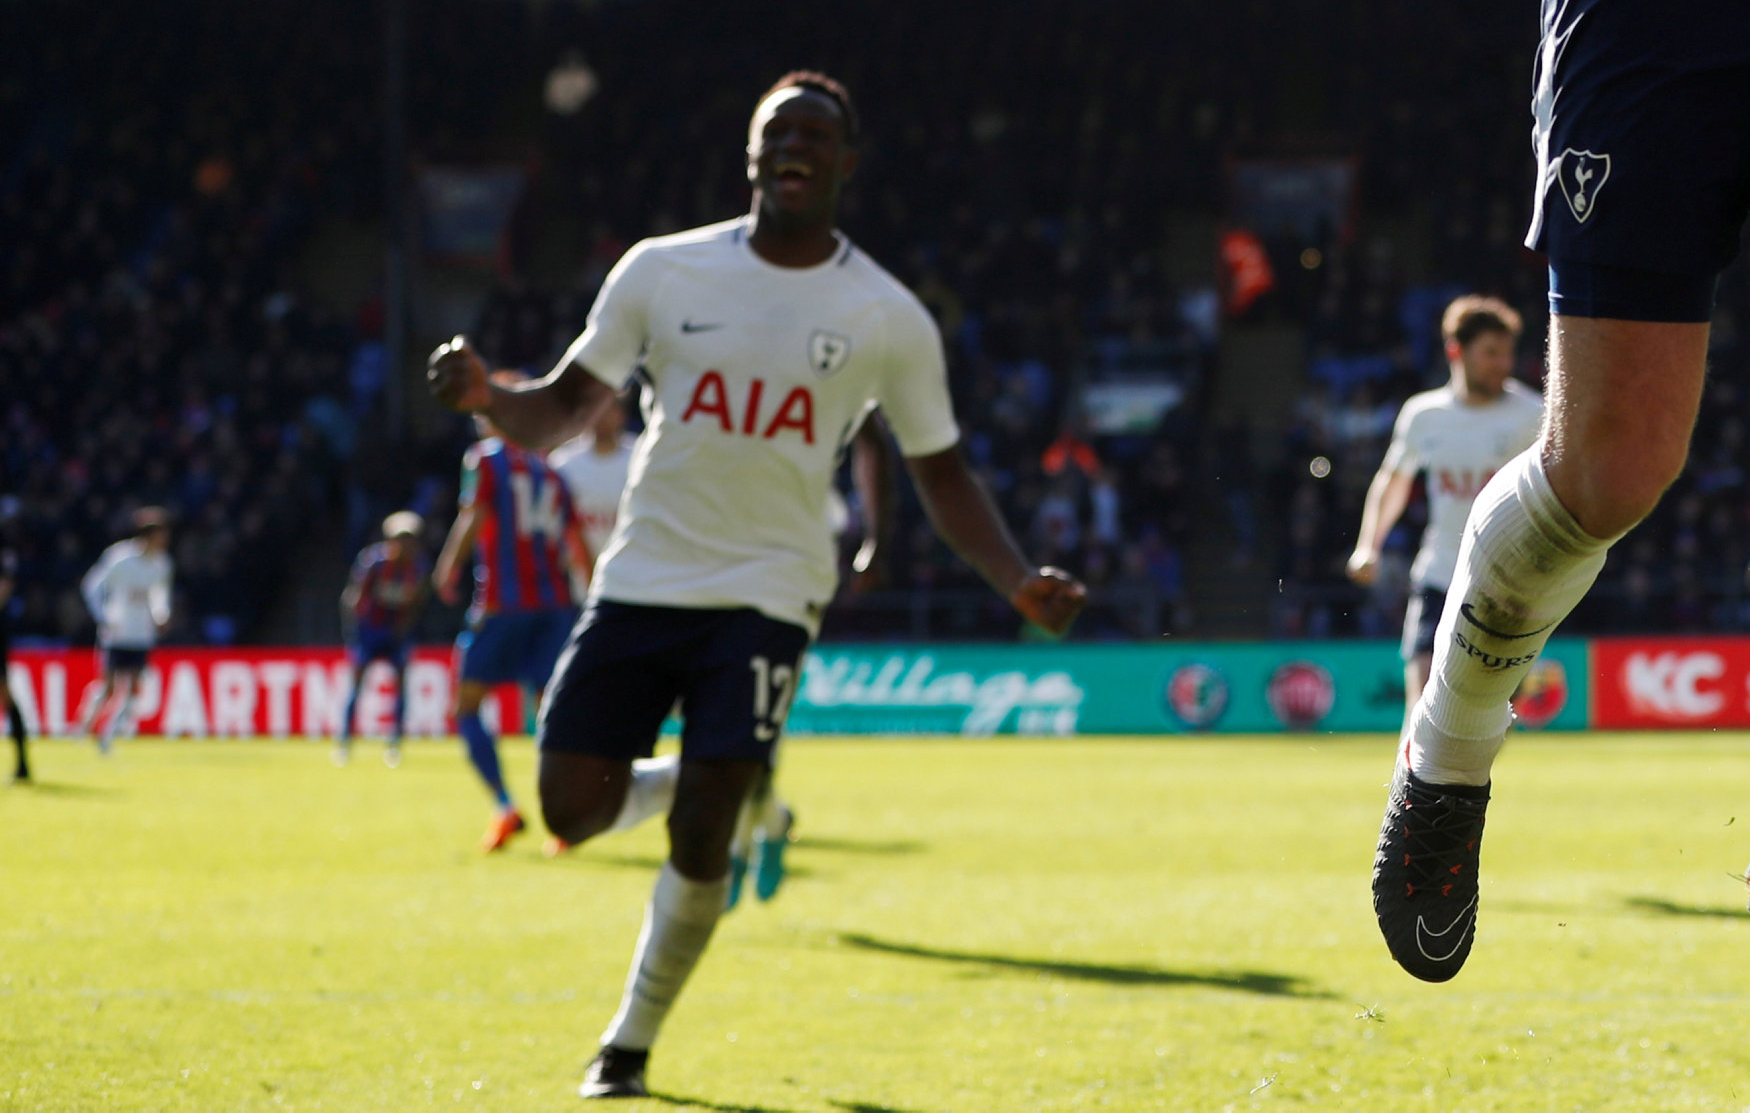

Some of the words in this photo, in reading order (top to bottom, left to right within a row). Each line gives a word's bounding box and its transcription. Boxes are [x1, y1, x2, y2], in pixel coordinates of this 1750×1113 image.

[682, 370, 816, 446] AIA
[510, 471, 564, 540] 14
[1455, 632, 1537, 668] SPURS
[1625, 651, 1724, 716] KC
